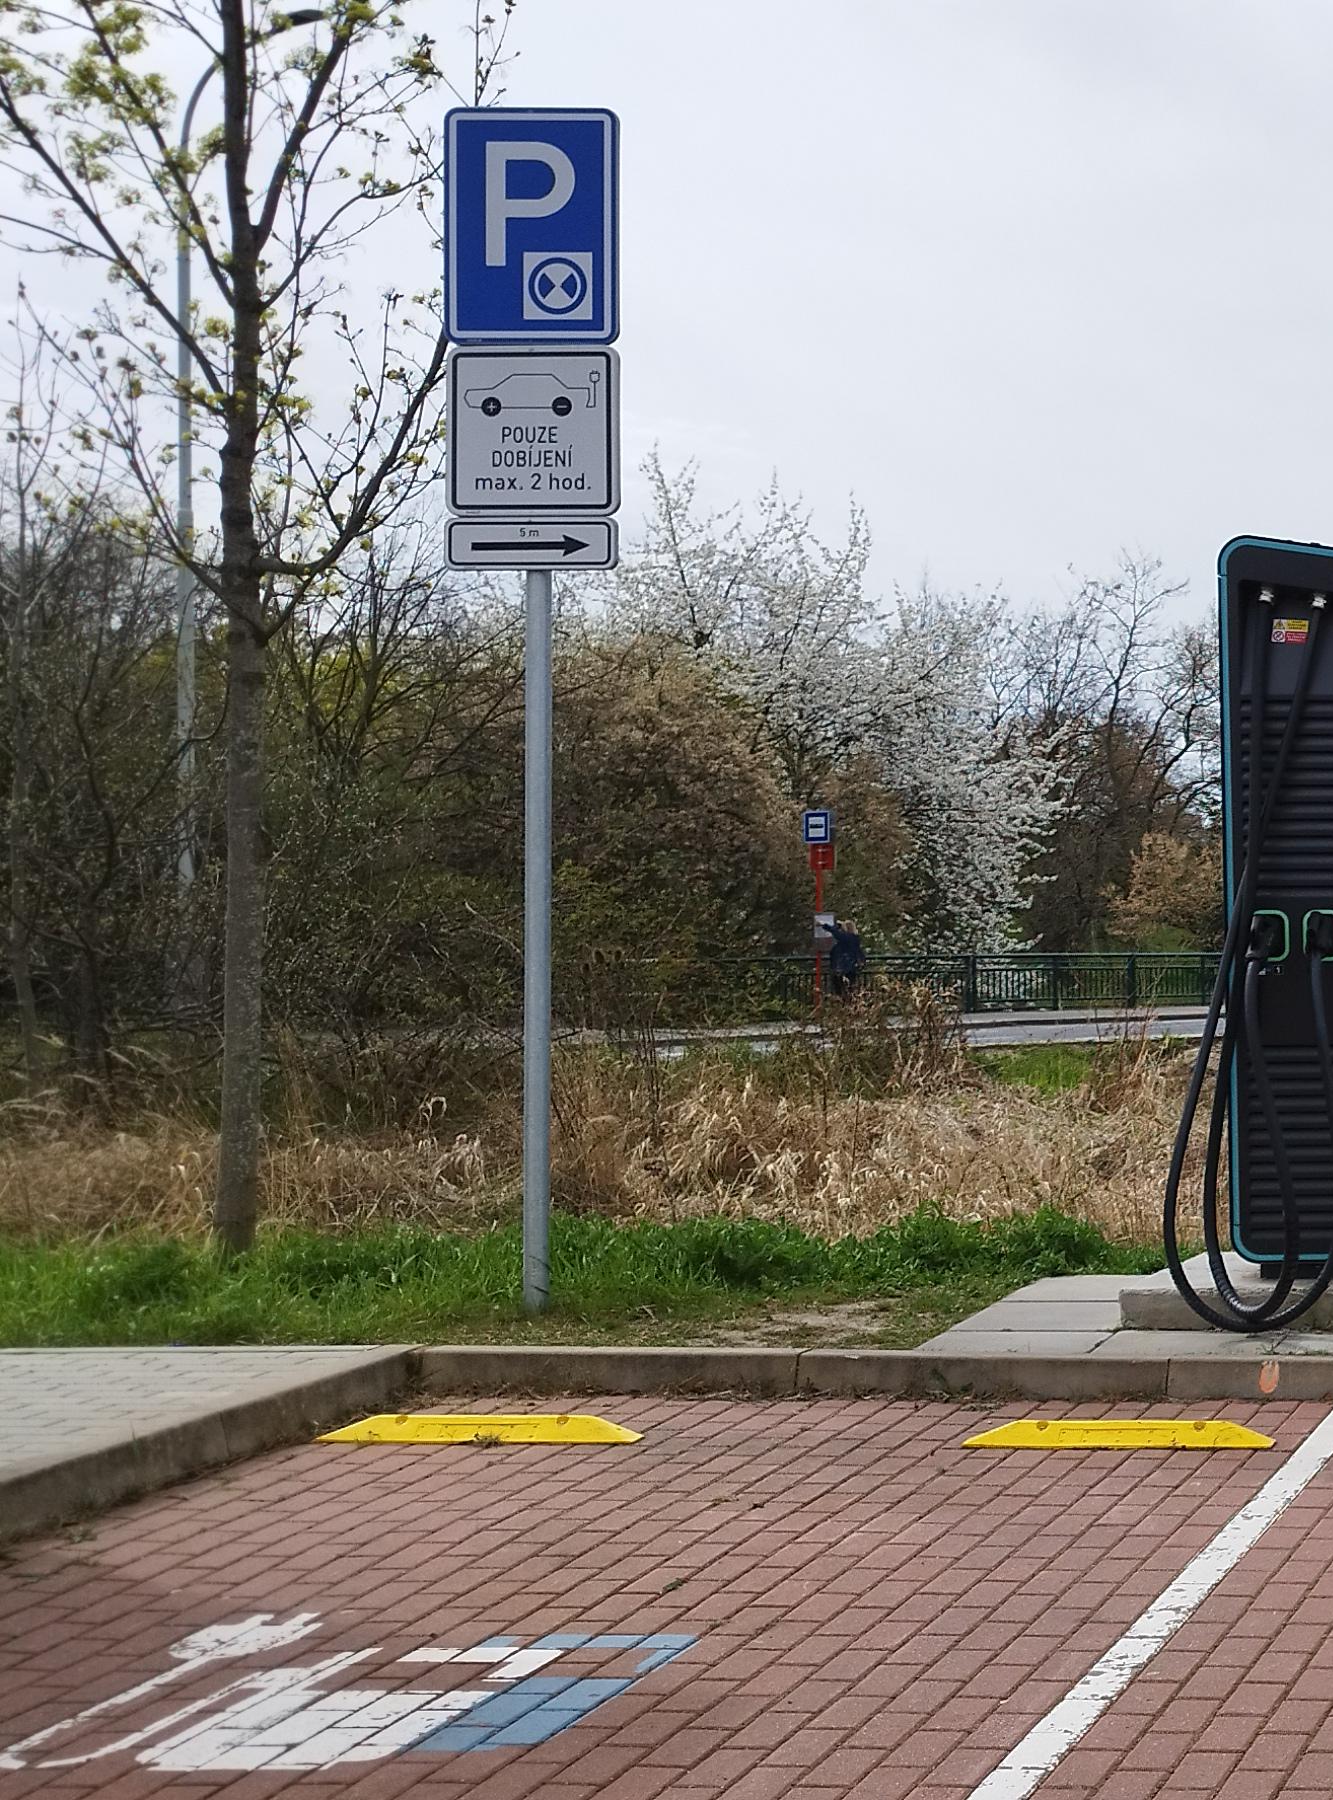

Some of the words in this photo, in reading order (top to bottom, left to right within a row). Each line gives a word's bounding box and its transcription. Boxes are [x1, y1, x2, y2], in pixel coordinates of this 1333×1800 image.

[485, 141, 575, 266] P
[502, 426, 558, 443] POUZE
[492, 444, 573, 467] DOBÍJENÍ
[475, 477, 523, 490] max.
[531, 473, 541, 490] 2
[549, 473, 591, 490] hod.
[520, 528, 526, 537] 5
